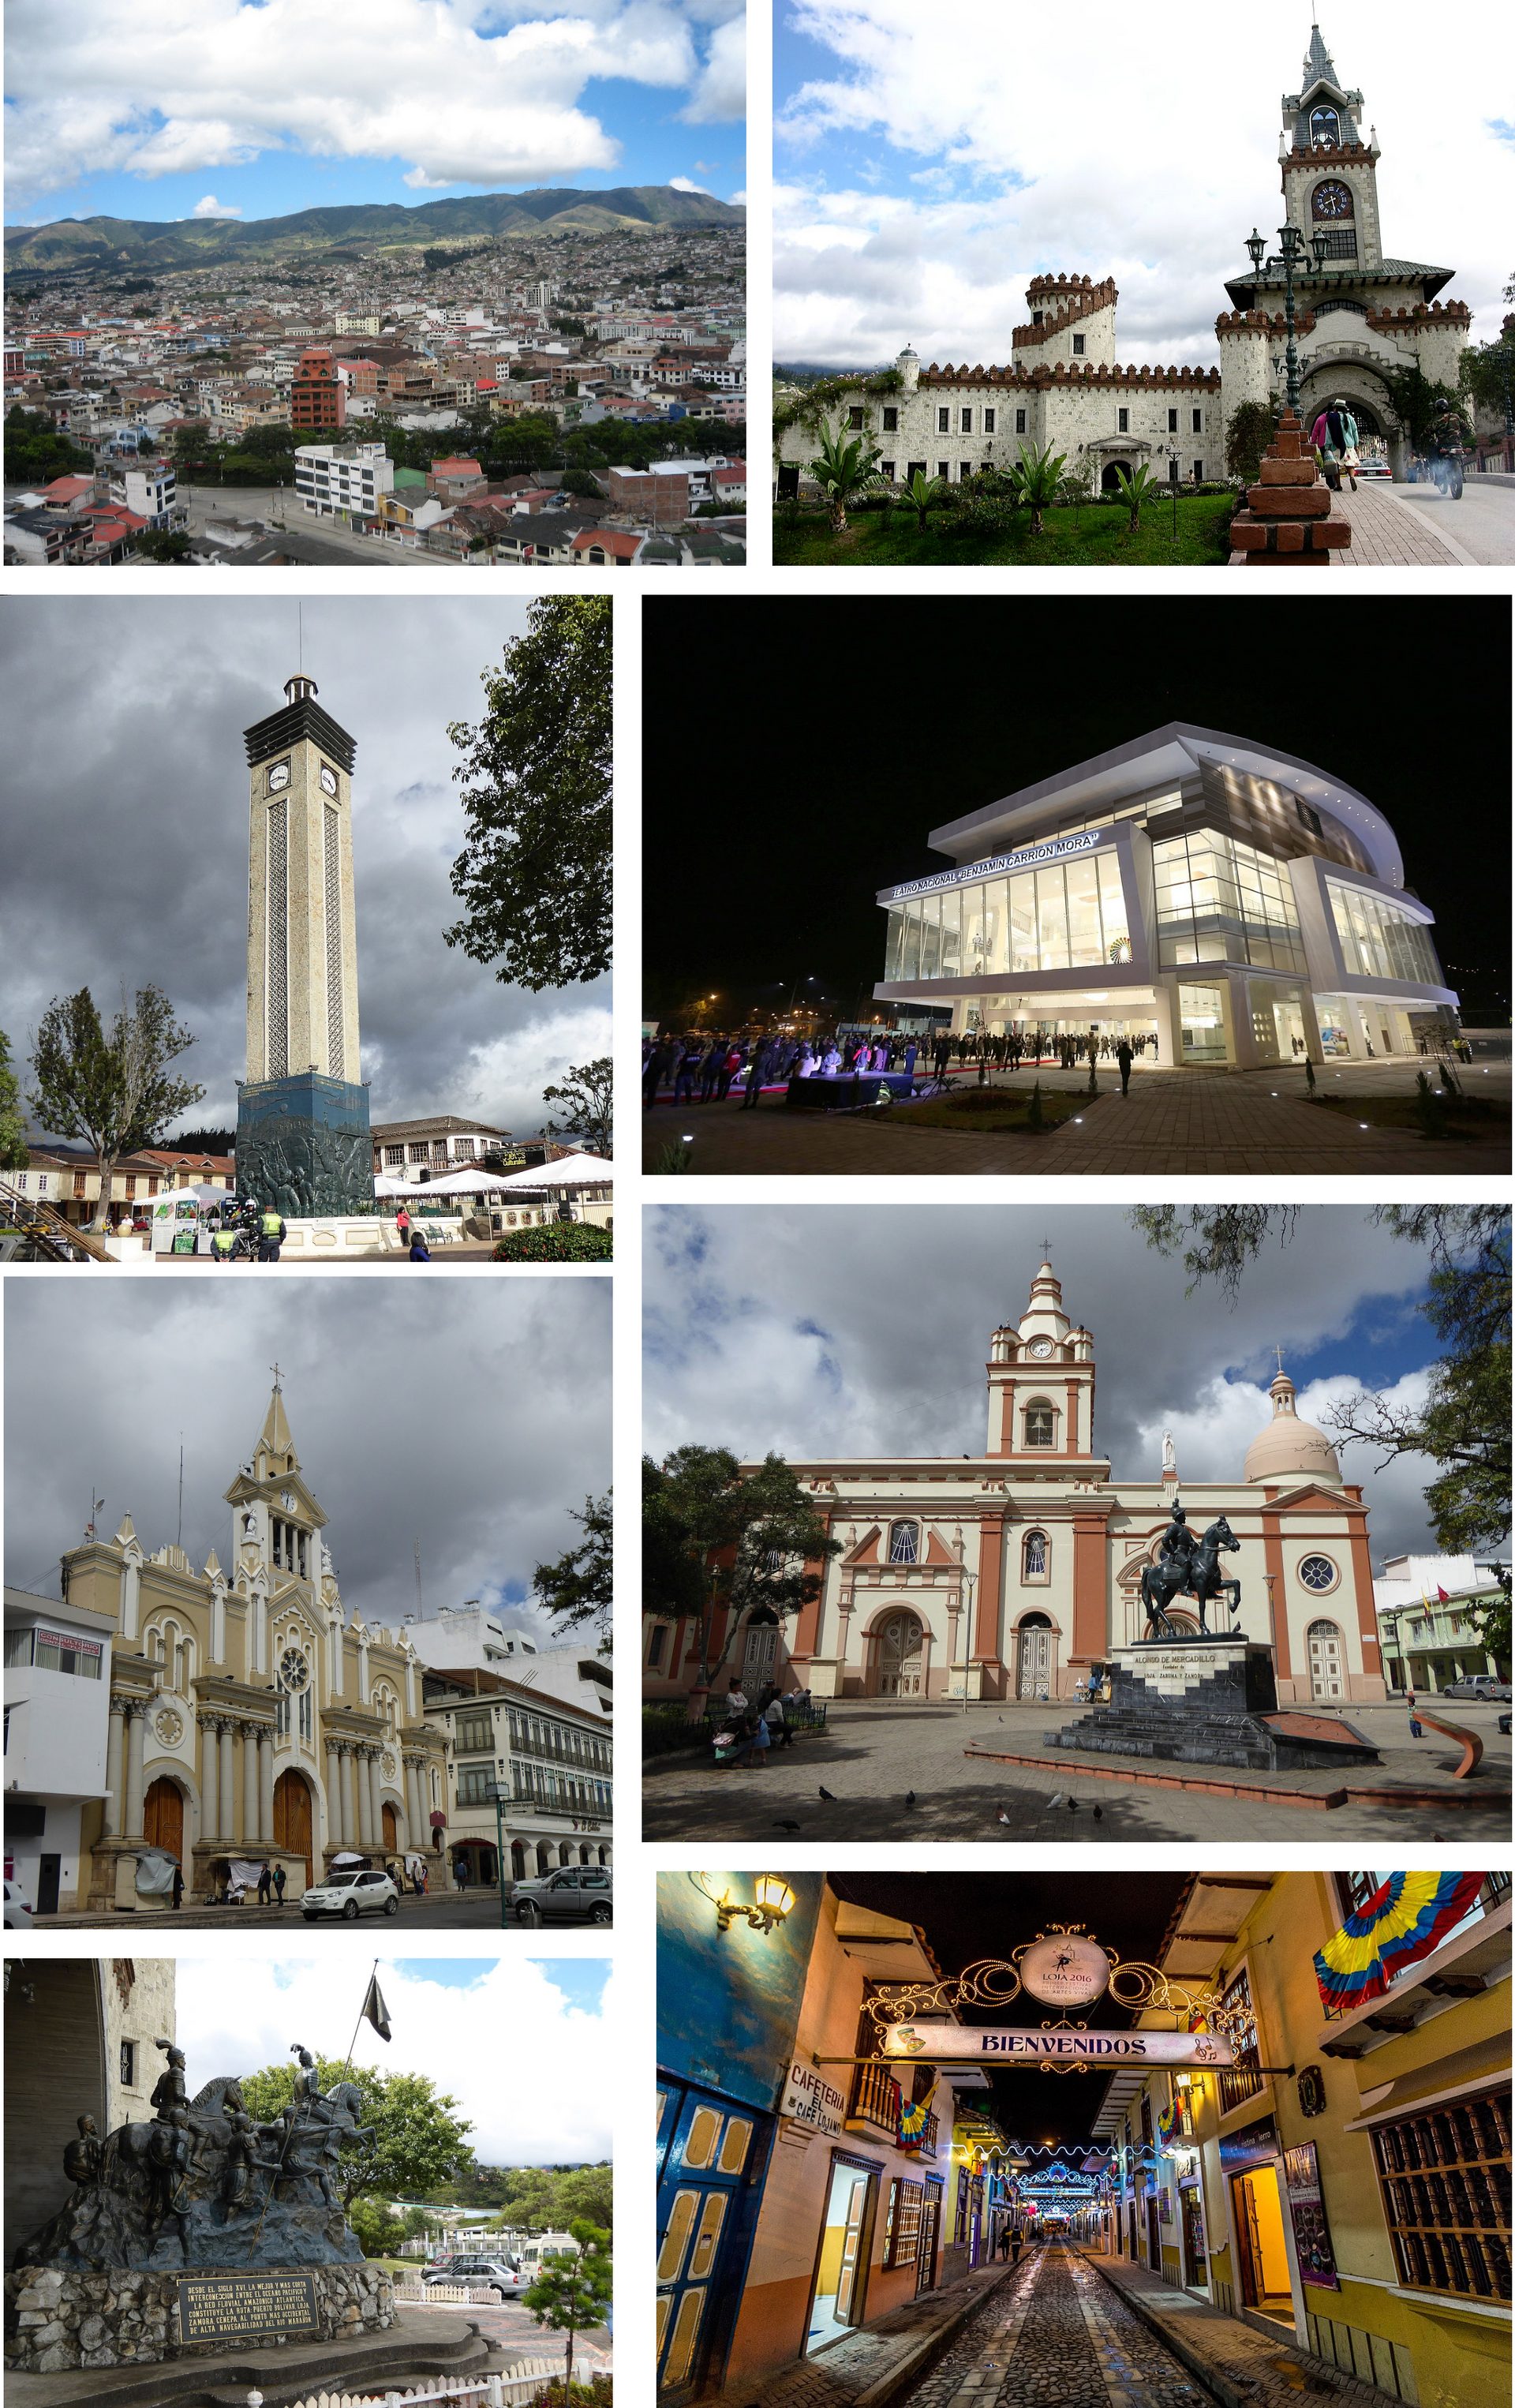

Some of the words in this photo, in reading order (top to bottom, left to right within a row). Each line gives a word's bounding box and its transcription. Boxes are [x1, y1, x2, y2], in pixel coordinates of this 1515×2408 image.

[892, 883, 918, 897] TEATRO
[918, 874, 956, 890] NACIONAL
[1007, 845, 1053, 866] CARRIÓN
[1057, 833, 1098, 853] MORA"
[40, 1633, 99, 1650] CONSULTORIO
[1070, 1974, 1092, 1983] 2016
[982, 2035, 1147, 2055] BIENVENIDOS
[811, 2096, 824, 2112] EL
[796, 2102, 817, 2123] CAFE
[817, 2112, 841, 2136] LOJANO
[218, 2299, 241, 2308] FLUVIAL
[244, 2298, 273, 2306] AMAZONICO
[189, 2309, 224, 2318] CONSTITUYE
[282, 2309, 311, 2318] OCCIDENTAL
[200, 2325, 215, 2334] ALTA
[219, 2320, 264, 2332] NAVEGABILIDAD
